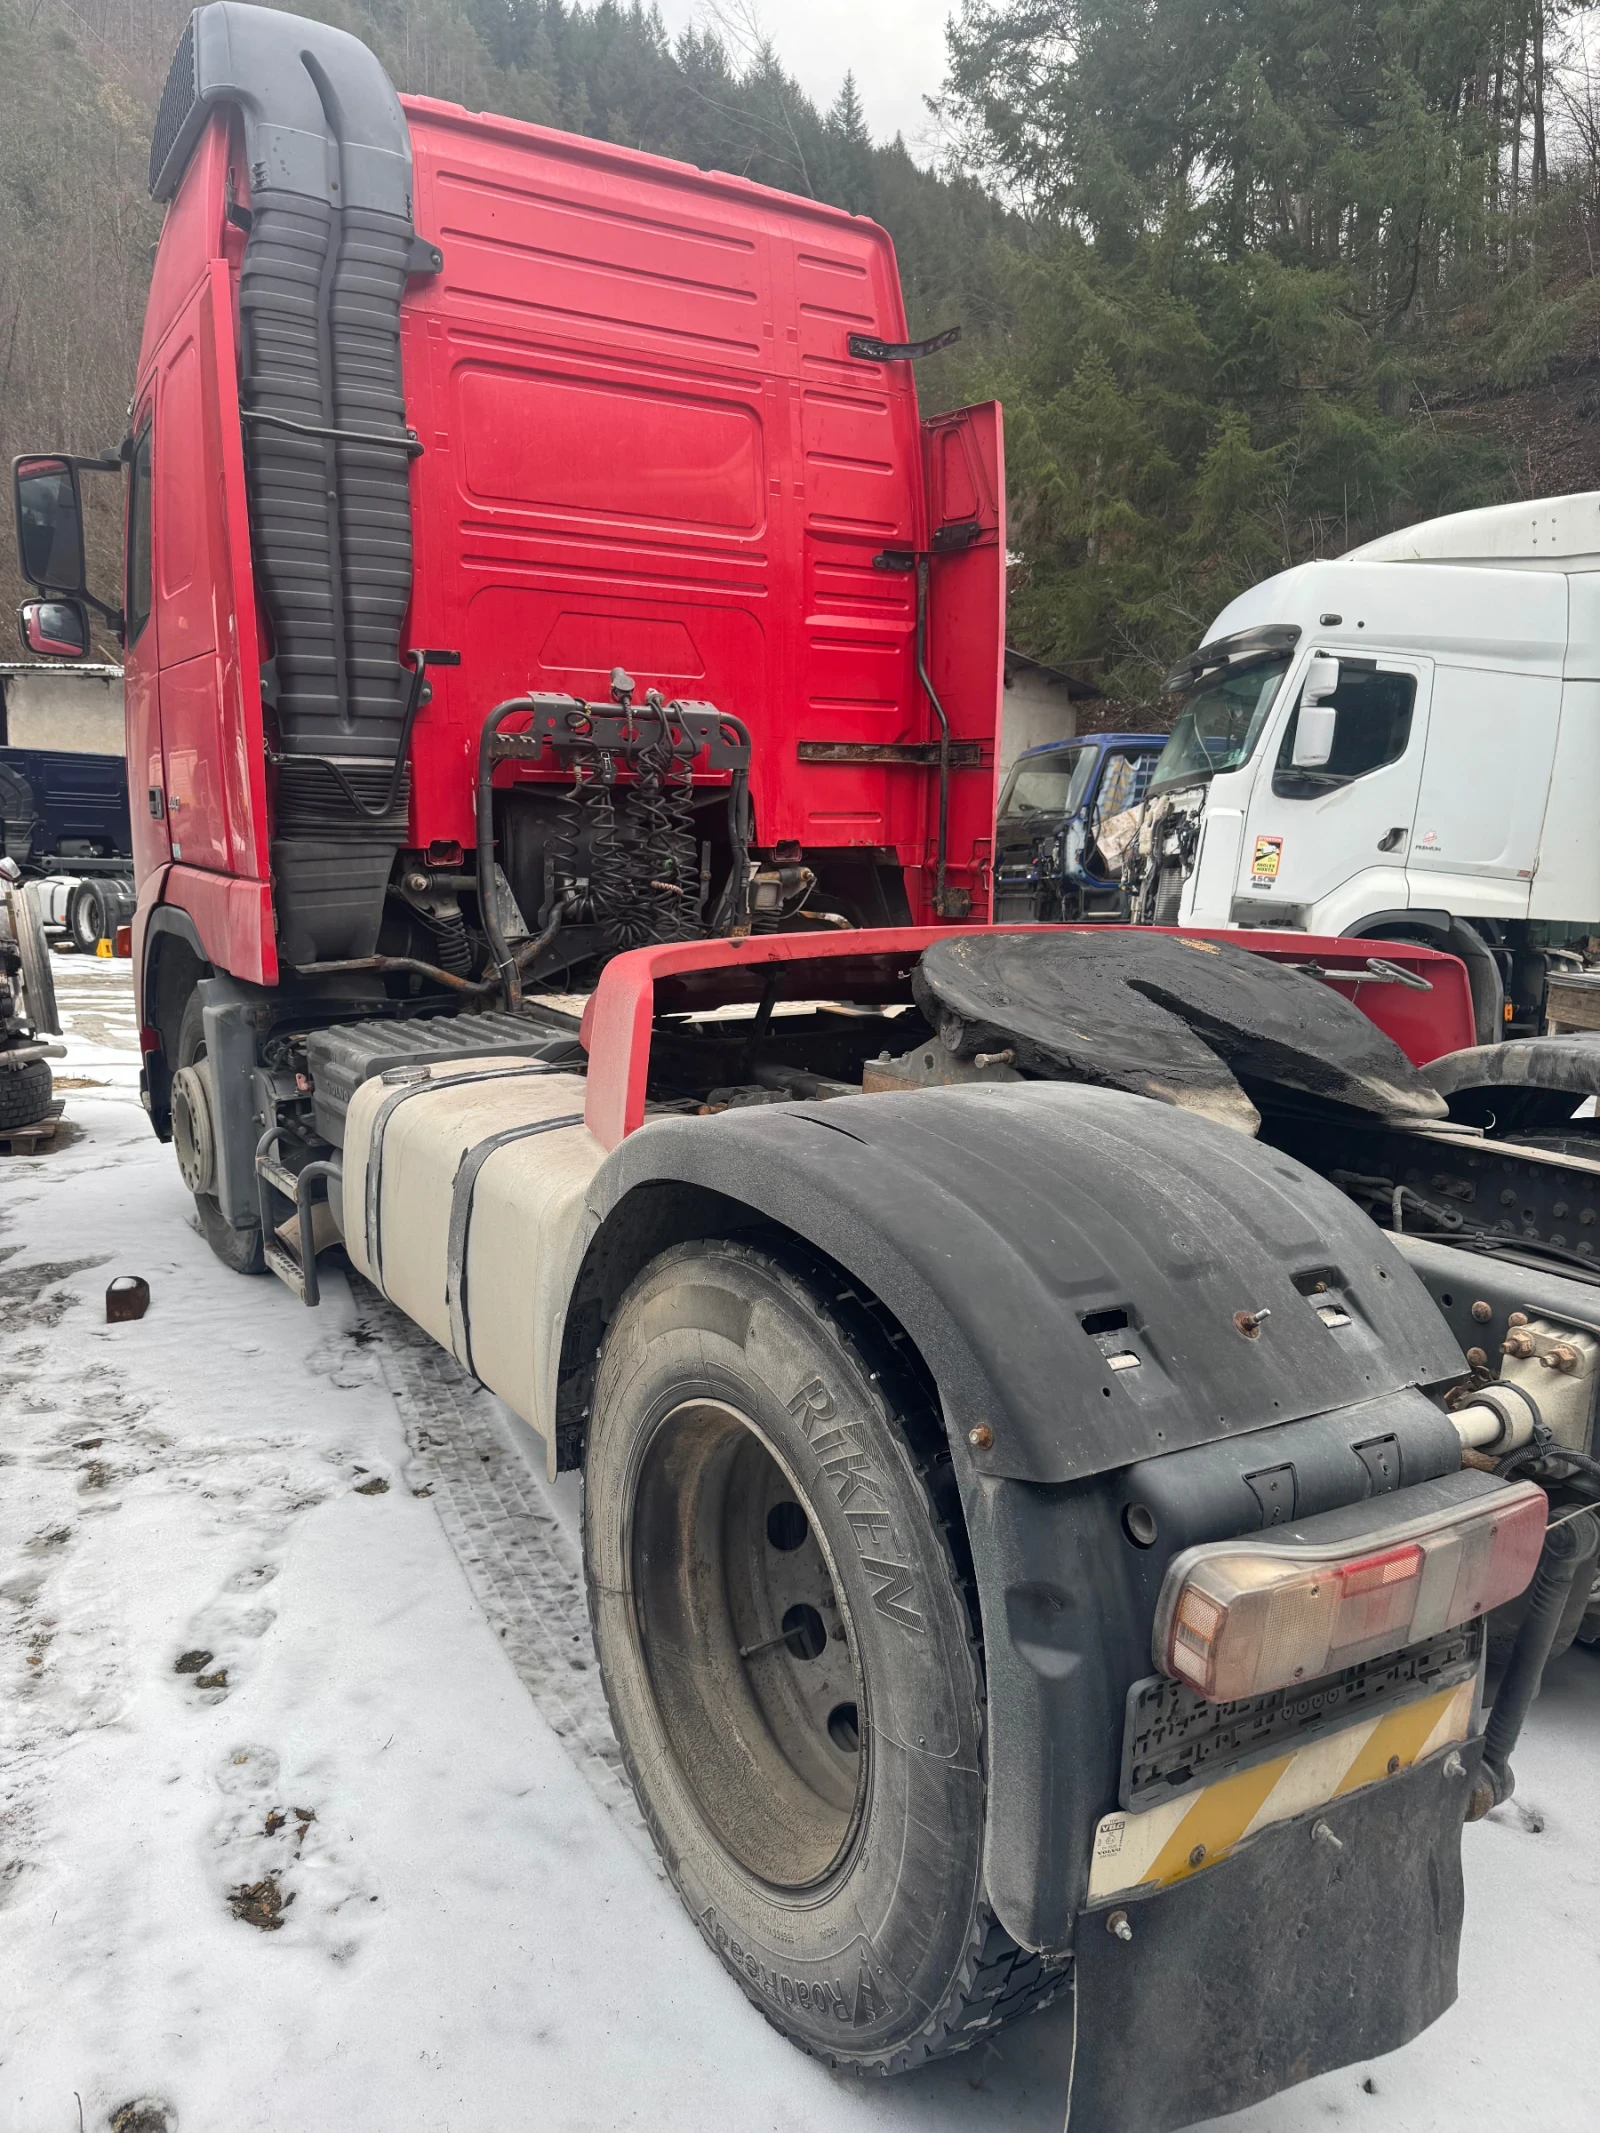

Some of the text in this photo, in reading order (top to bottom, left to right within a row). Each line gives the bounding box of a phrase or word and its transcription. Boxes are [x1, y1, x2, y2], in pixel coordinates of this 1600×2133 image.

[785, 1377, 925, 1633] RIKEN
[1101, 1822, 1125, 1832] VBG
[700, 1904, 853, 2023] RoadReady
